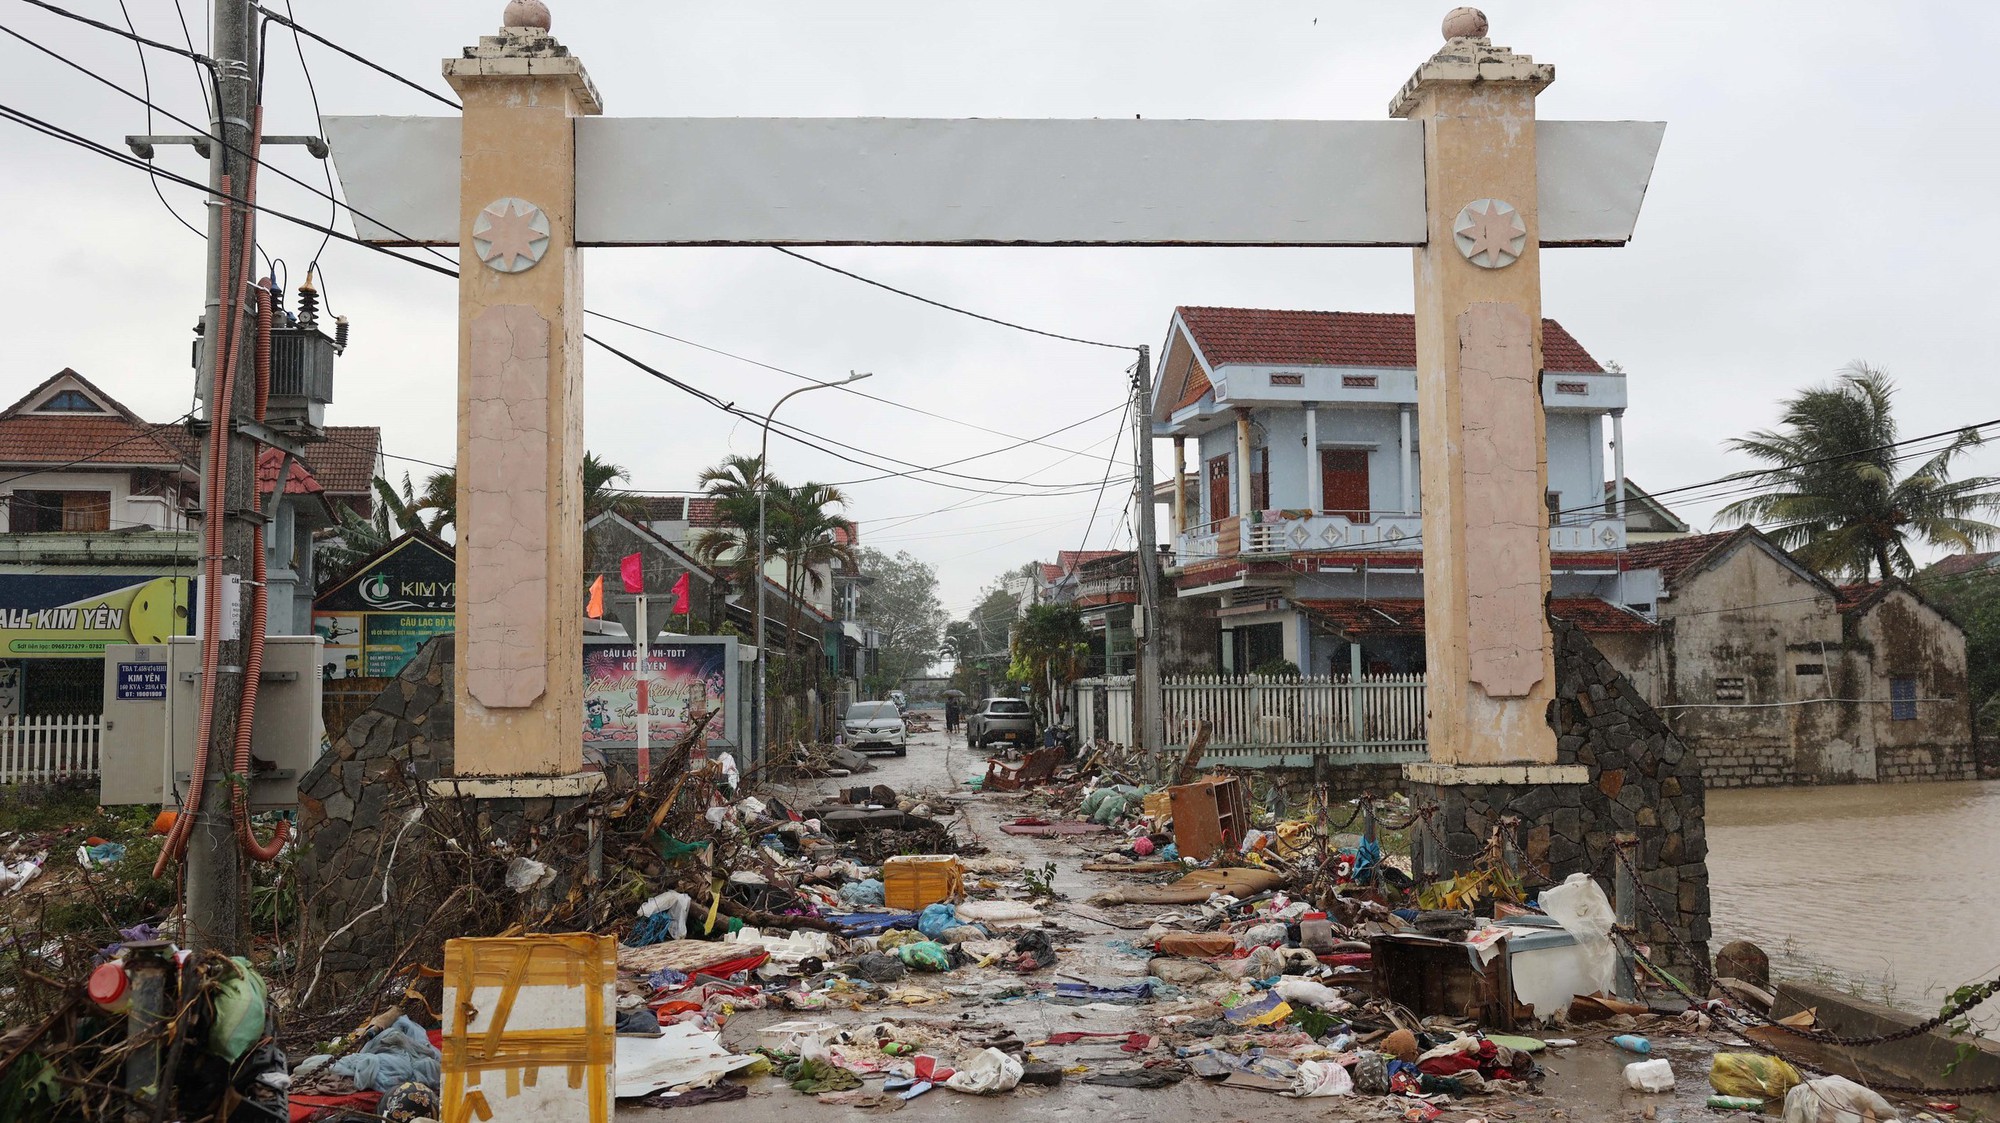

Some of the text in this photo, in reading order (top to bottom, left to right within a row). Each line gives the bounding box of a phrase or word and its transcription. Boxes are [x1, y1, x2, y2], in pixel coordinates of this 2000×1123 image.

[401, 581, 436, 597] KIM
[36, 608, 78, 629] KIM
[82, 602, 123, 629] YÊN
[400, 616, 417, 627] CÂU
[418, 617, 434, 629] LẠC
[435, 616, 446, 629] BỘ
[603, 648, 620, 657] CÂU
[127, 672, 160, 682] KIM YÊN
